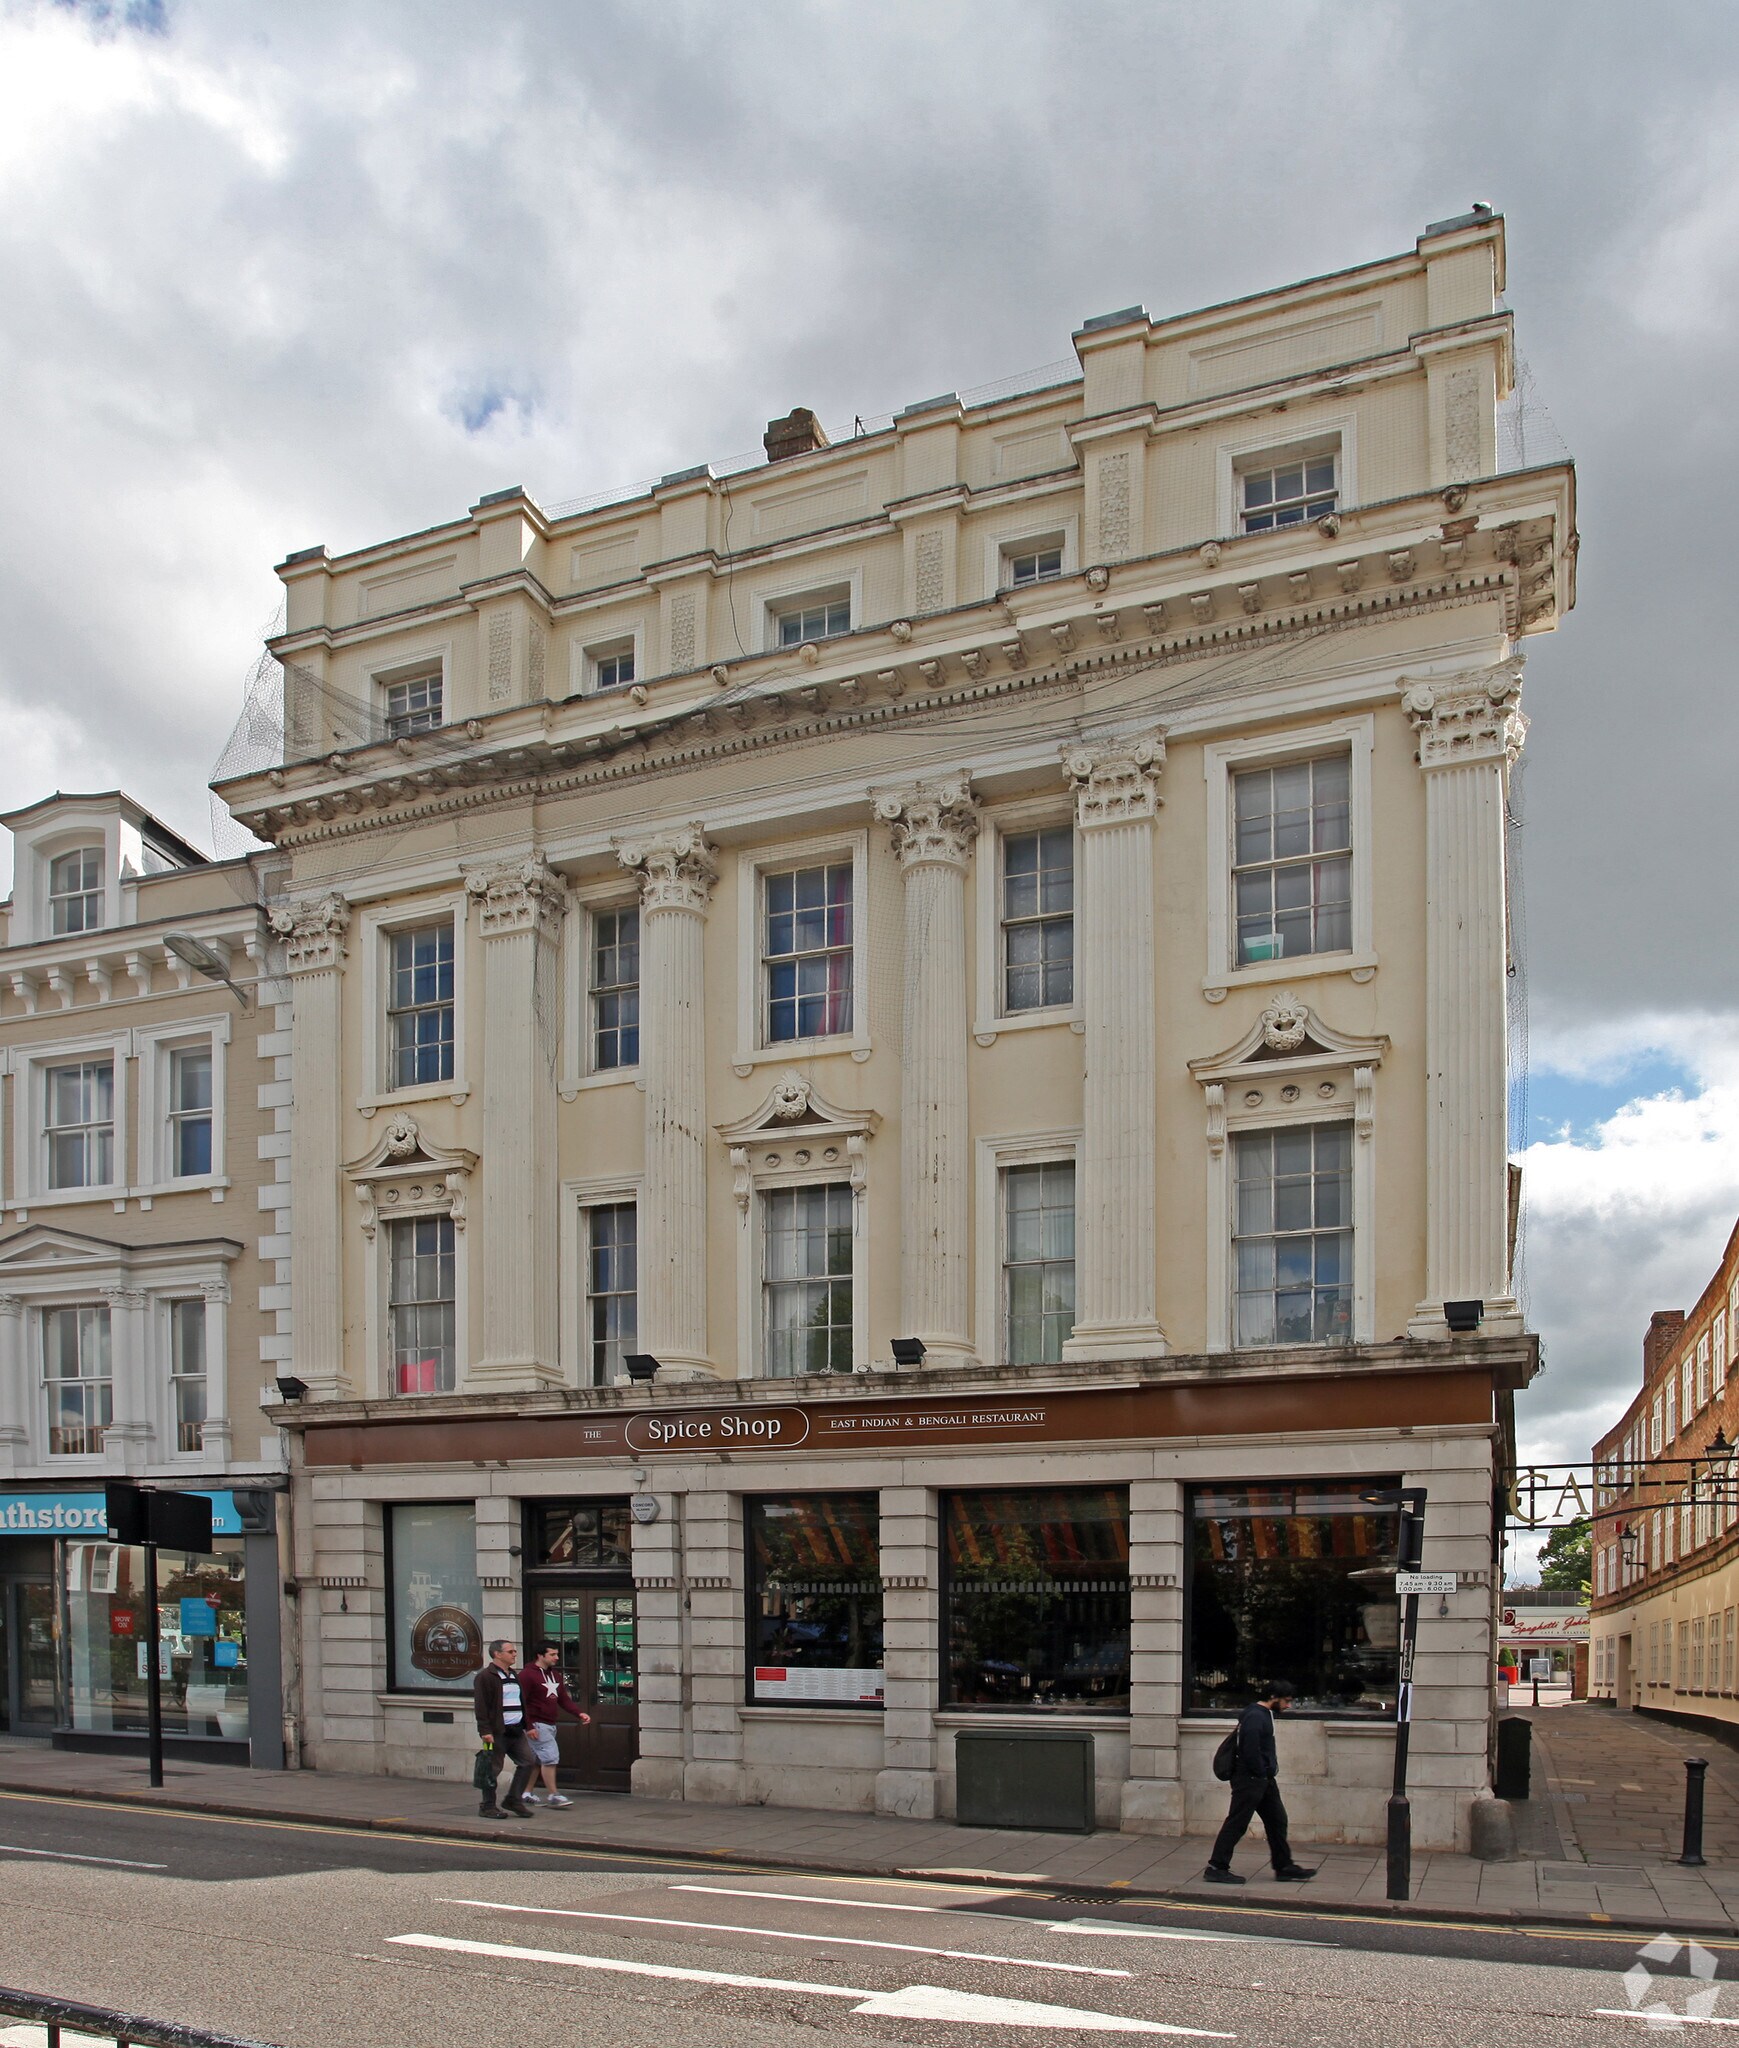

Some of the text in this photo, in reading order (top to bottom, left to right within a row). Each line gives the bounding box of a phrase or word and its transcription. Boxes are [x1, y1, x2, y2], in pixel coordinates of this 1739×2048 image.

[830, 1412, 1046, 1428] EAST INDIAN & BENGALI RESTAURANT
[583, 1430, 602, 1439] THE
[648, 1416, 782, 1443] Spice Shop
[1508, 1466, 1706, 1523] CASTLE
[1511, 1621, 1560, 1635] Spaghetti
[422, 1655, 474, 1665] Spice Shop
[141, 1664, 168, 1675] SE
